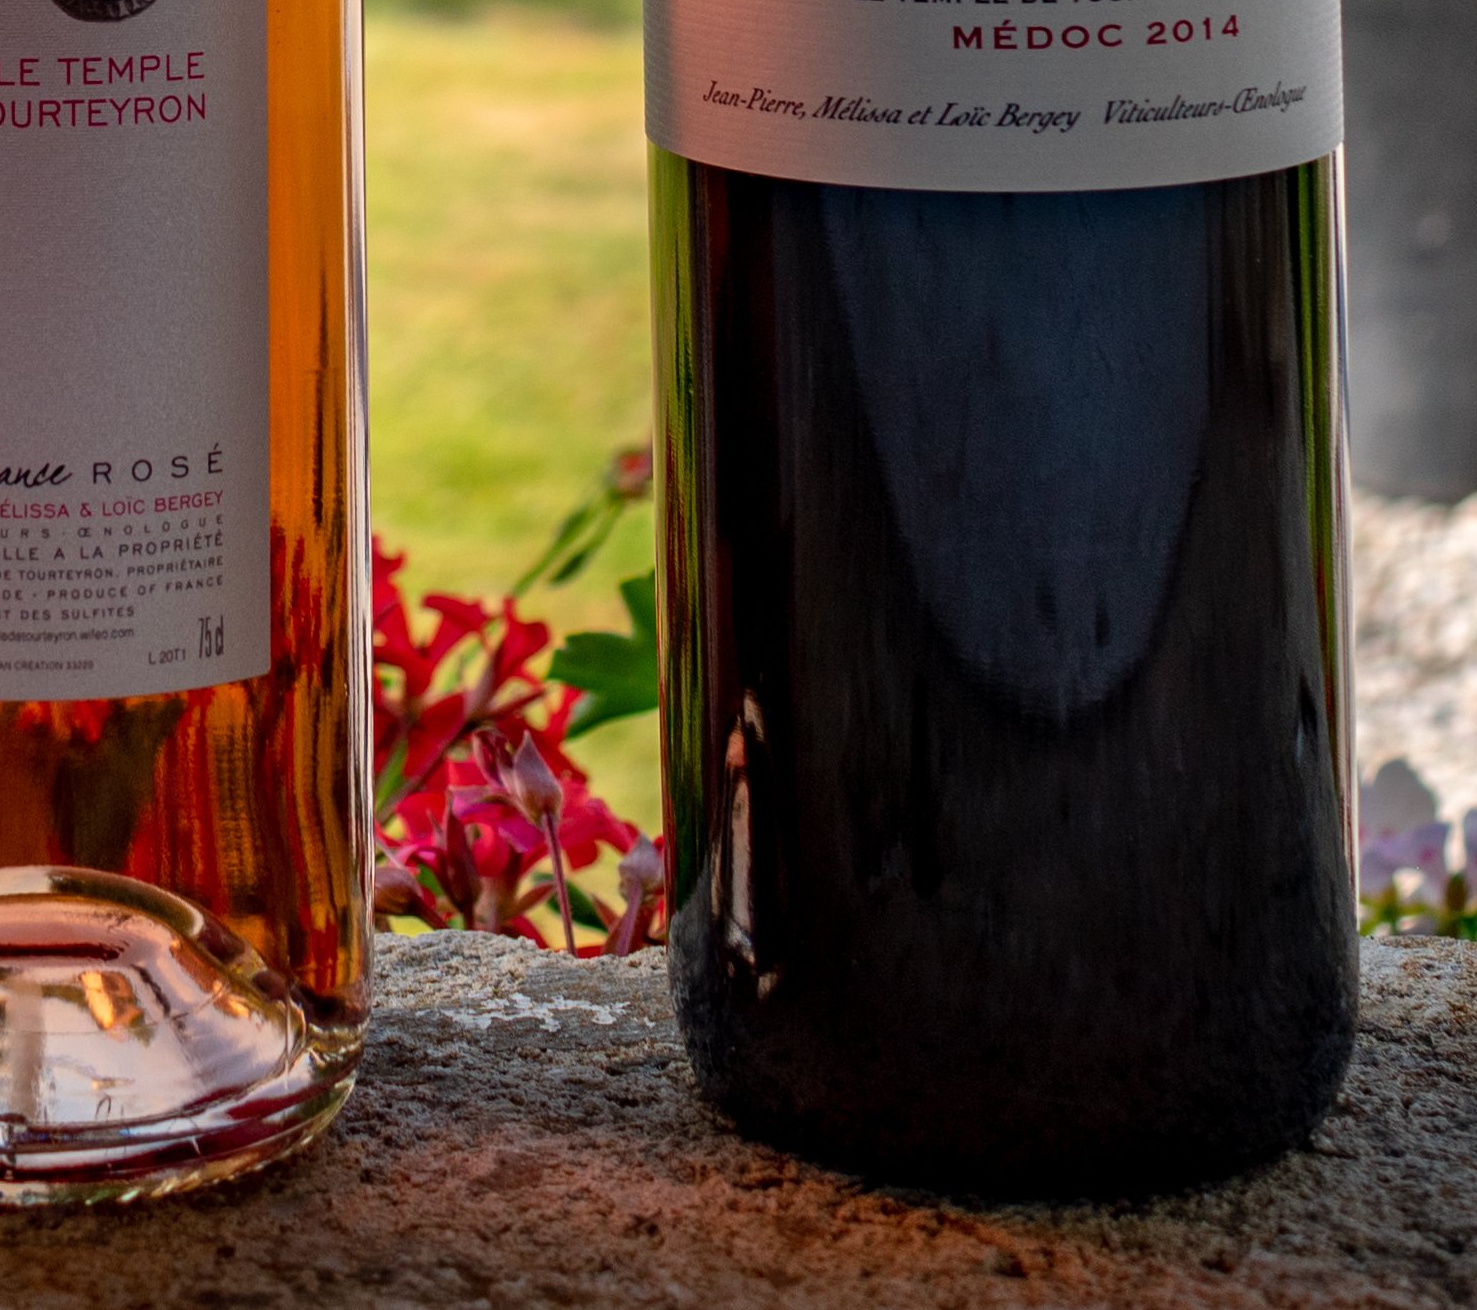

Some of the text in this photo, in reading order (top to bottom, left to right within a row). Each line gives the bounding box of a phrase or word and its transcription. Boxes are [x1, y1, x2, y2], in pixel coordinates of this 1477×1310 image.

[952, 14, 1240, 50] MÉDOC 2014
[57, 52, 206, 86] TEMPLE
[702, 79, 807, 120] Jean-Pierre,
[811, 95, 901, 125] Mélissa
[906, 105, 933, 125] et
[934, 102, 991, 127] Loïc
[994, 102, 1082, 134] Bergey
[92, 441, 224, 486] ROSÉ
[79, 502, 93, 519] &
[101, 495, 146, 518] LOÏC
[153, 490, 224, 514] BERGEY
[52, 545, 66, 561] A
[79, 545, 105, 560] LA
[117, 528, 224, 558] PROPRIÉTÉ
[126, 554, 224, 578] PROPRIÉTAIRE
[46, 585, 129, 601] PRODUCE
[136, 583, 158, 597] OF
[164, 573, 224, 594] FRANCE
[19, 608, 52, 622] DES
[60, 604, 136, 621] SULFITES
[196, 615, 213, 660] 75
